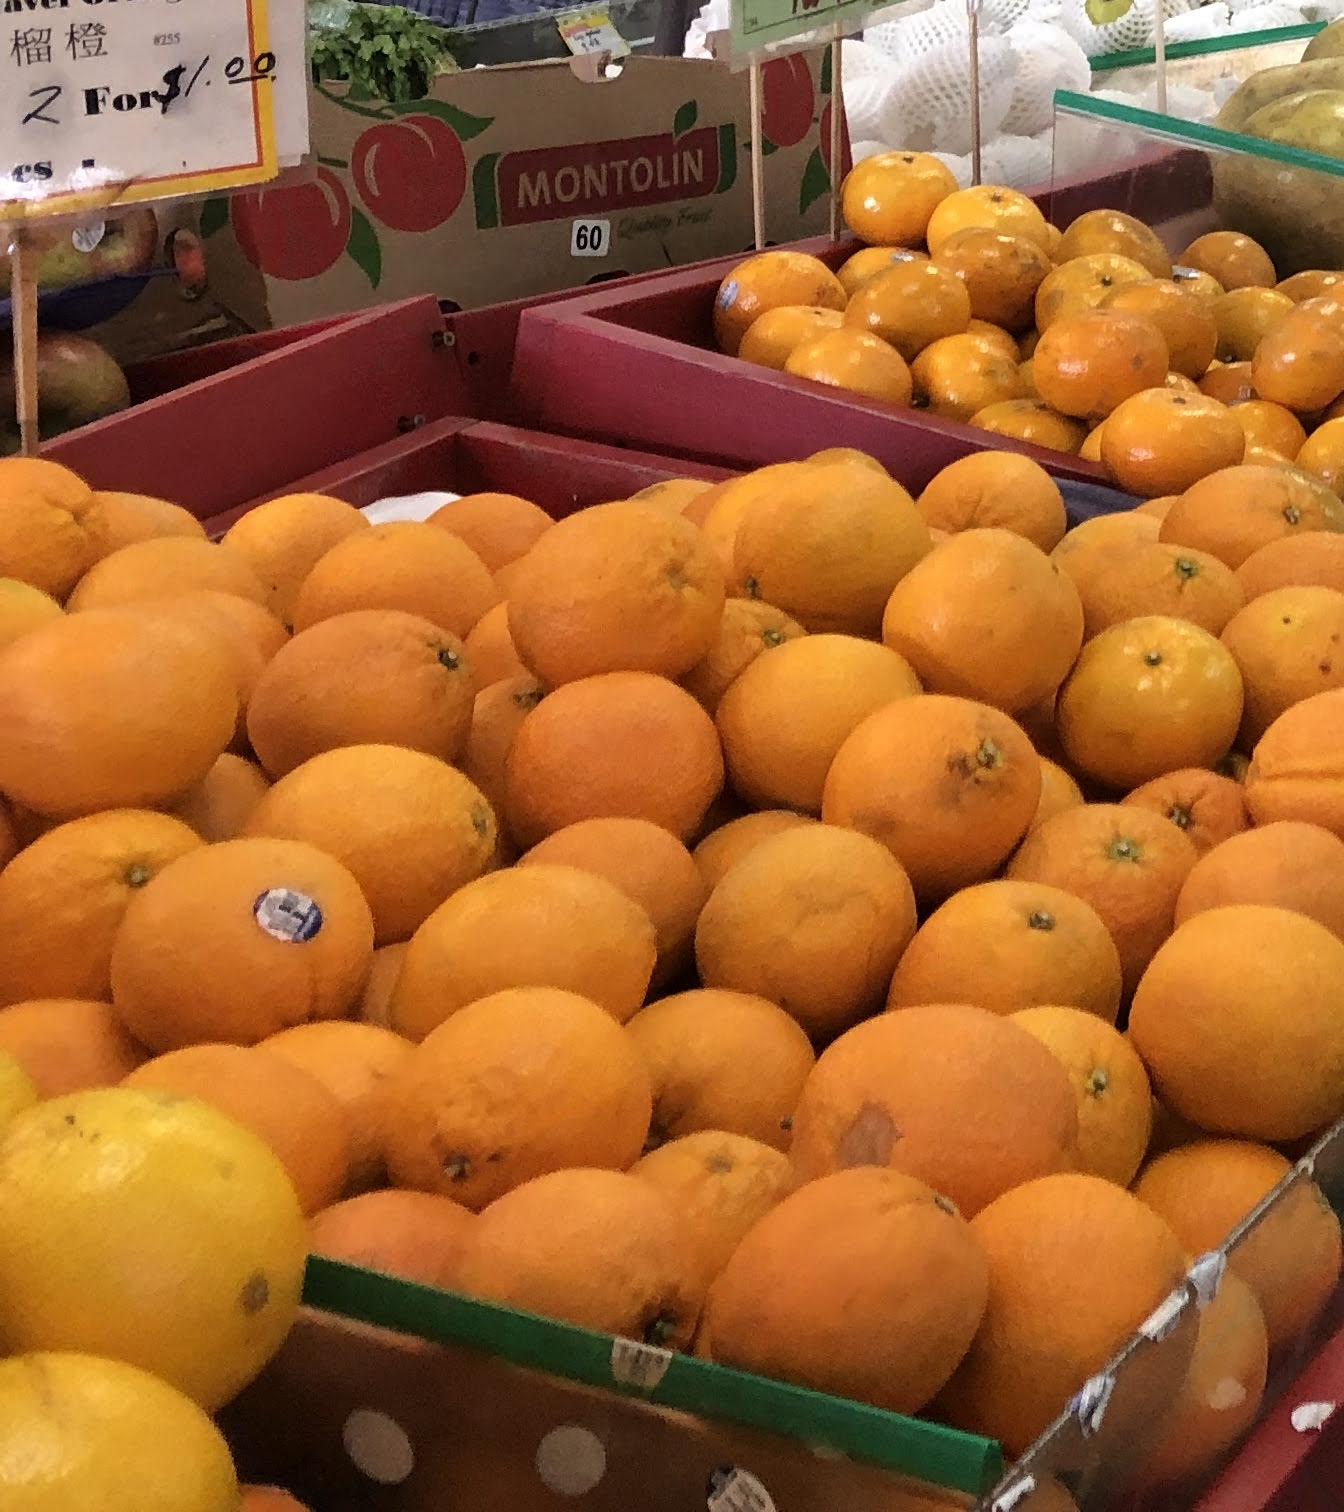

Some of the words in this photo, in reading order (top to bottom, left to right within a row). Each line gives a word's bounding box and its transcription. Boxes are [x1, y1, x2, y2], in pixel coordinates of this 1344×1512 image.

[22, 85, 62, 125] 2
[517, 148, 703, 209] MONTOLIN
[575, 224, 603, 251] 60
